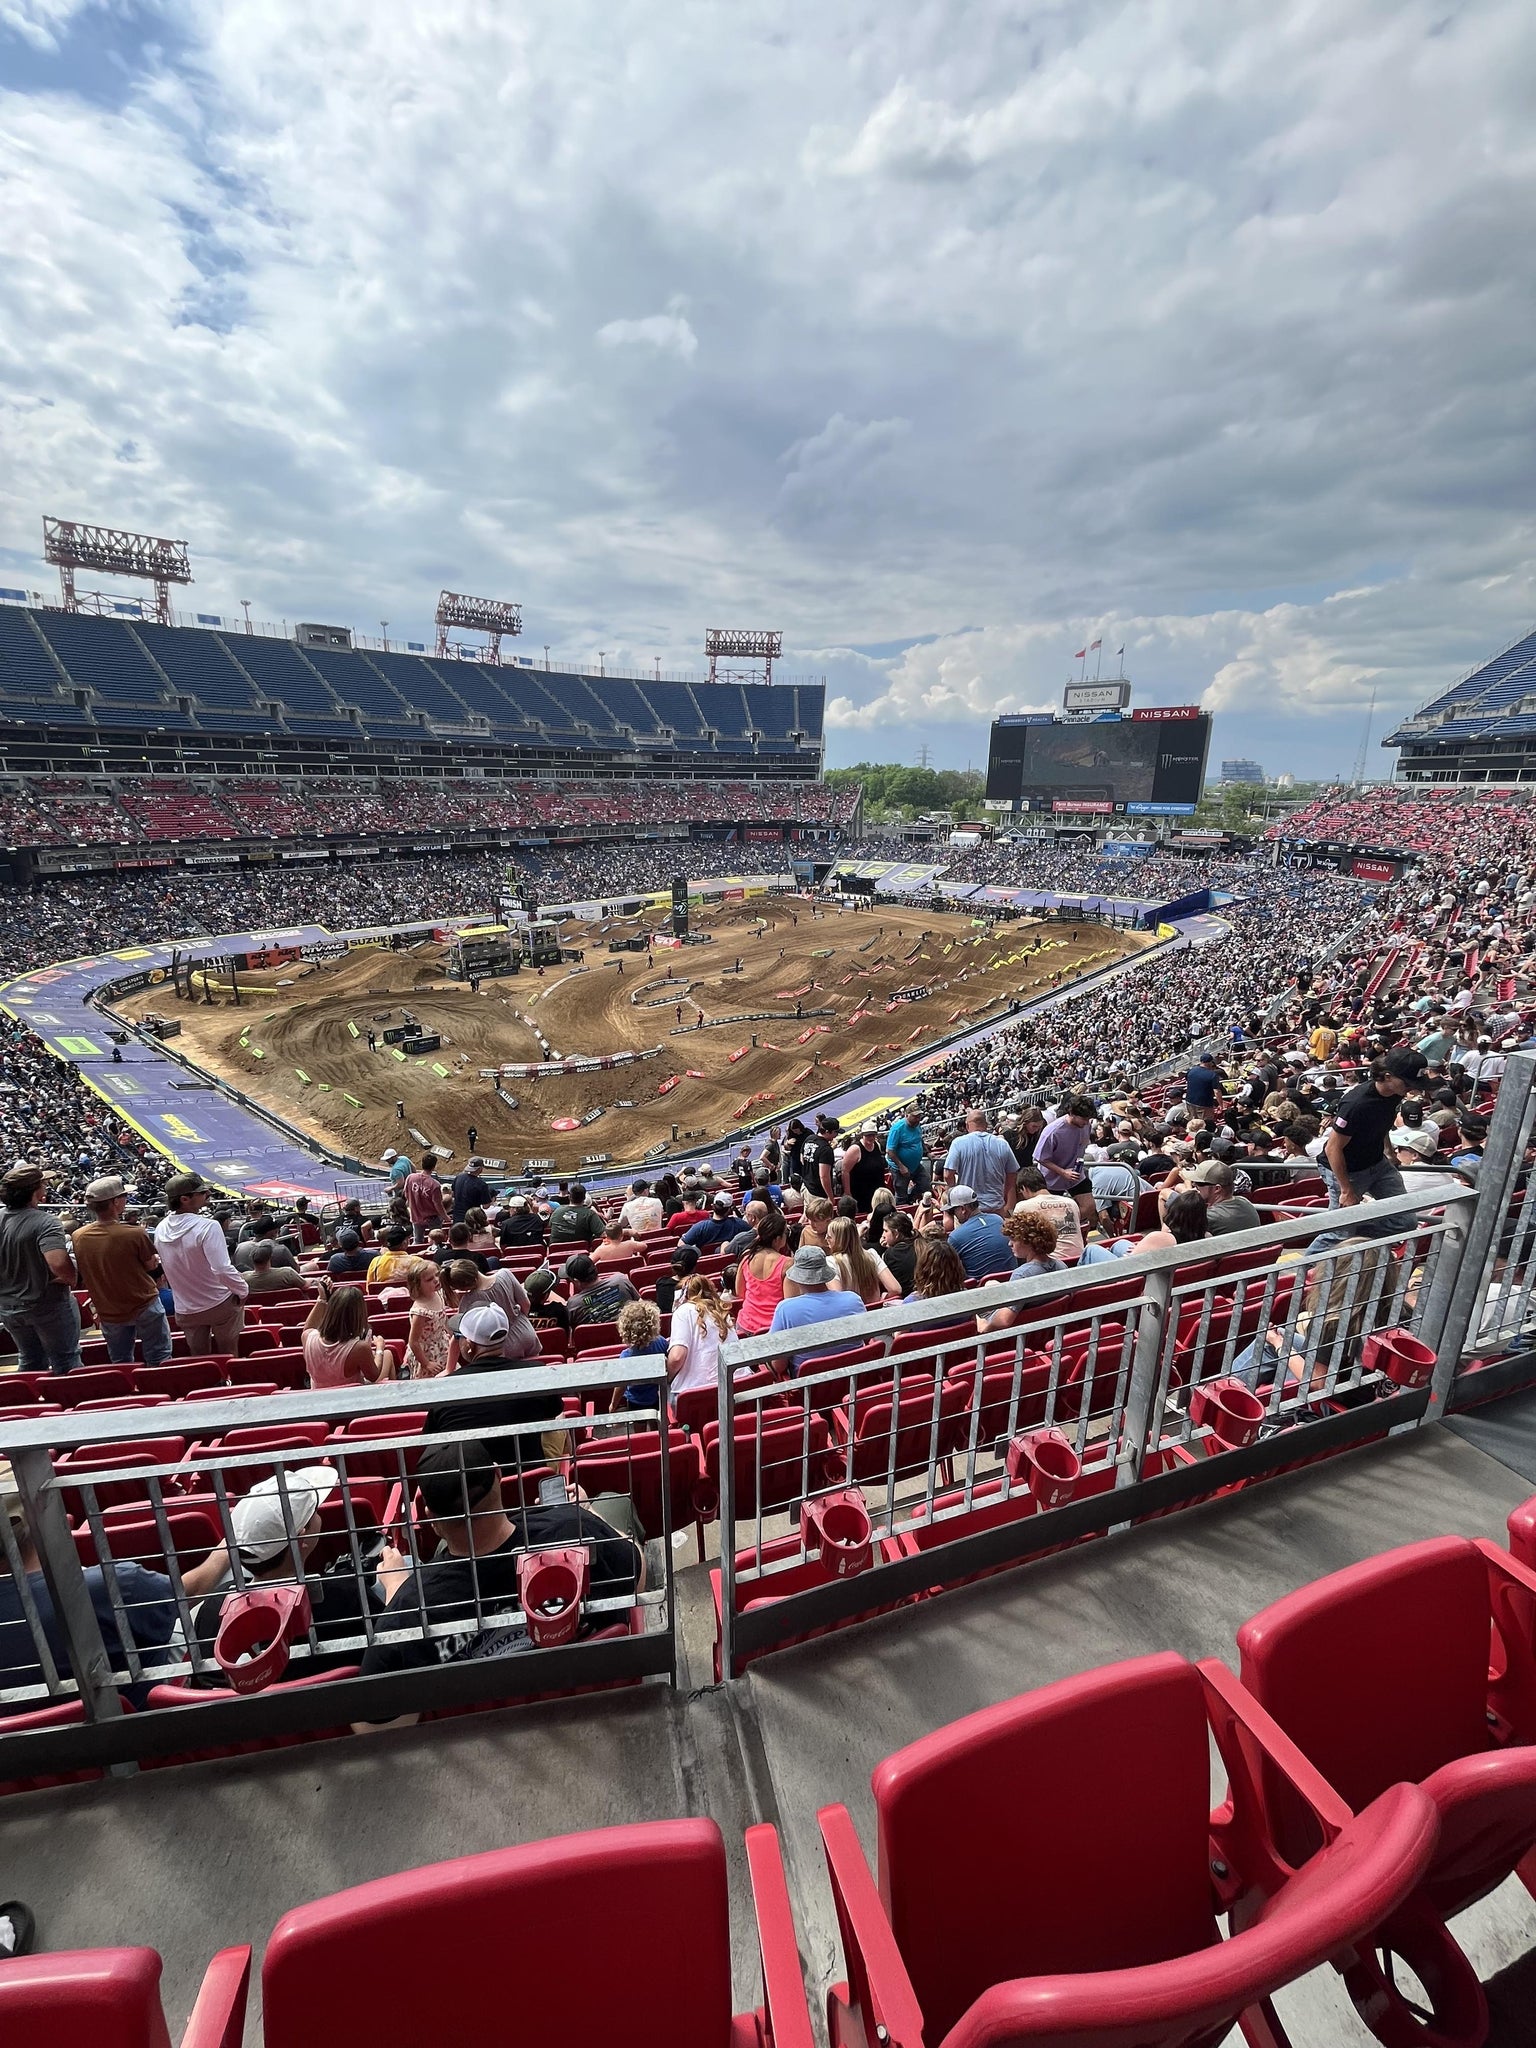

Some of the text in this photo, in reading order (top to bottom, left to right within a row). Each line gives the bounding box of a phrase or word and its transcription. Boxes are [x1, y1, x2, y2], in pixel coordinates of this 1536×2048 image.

[1073, 690, 1113, 699] NISSAN
[1140, 709, 1190, 719] NISSAN
[1356, 862, 1390, 872] NISSAN
[499, 897, 523, 909] FINISH
[350, 935, 392, 947] SUZUKI
[542, 1624, 572, 1641] Coca-Cola
[237, 1665, 273, 1688] Coca-Cola
